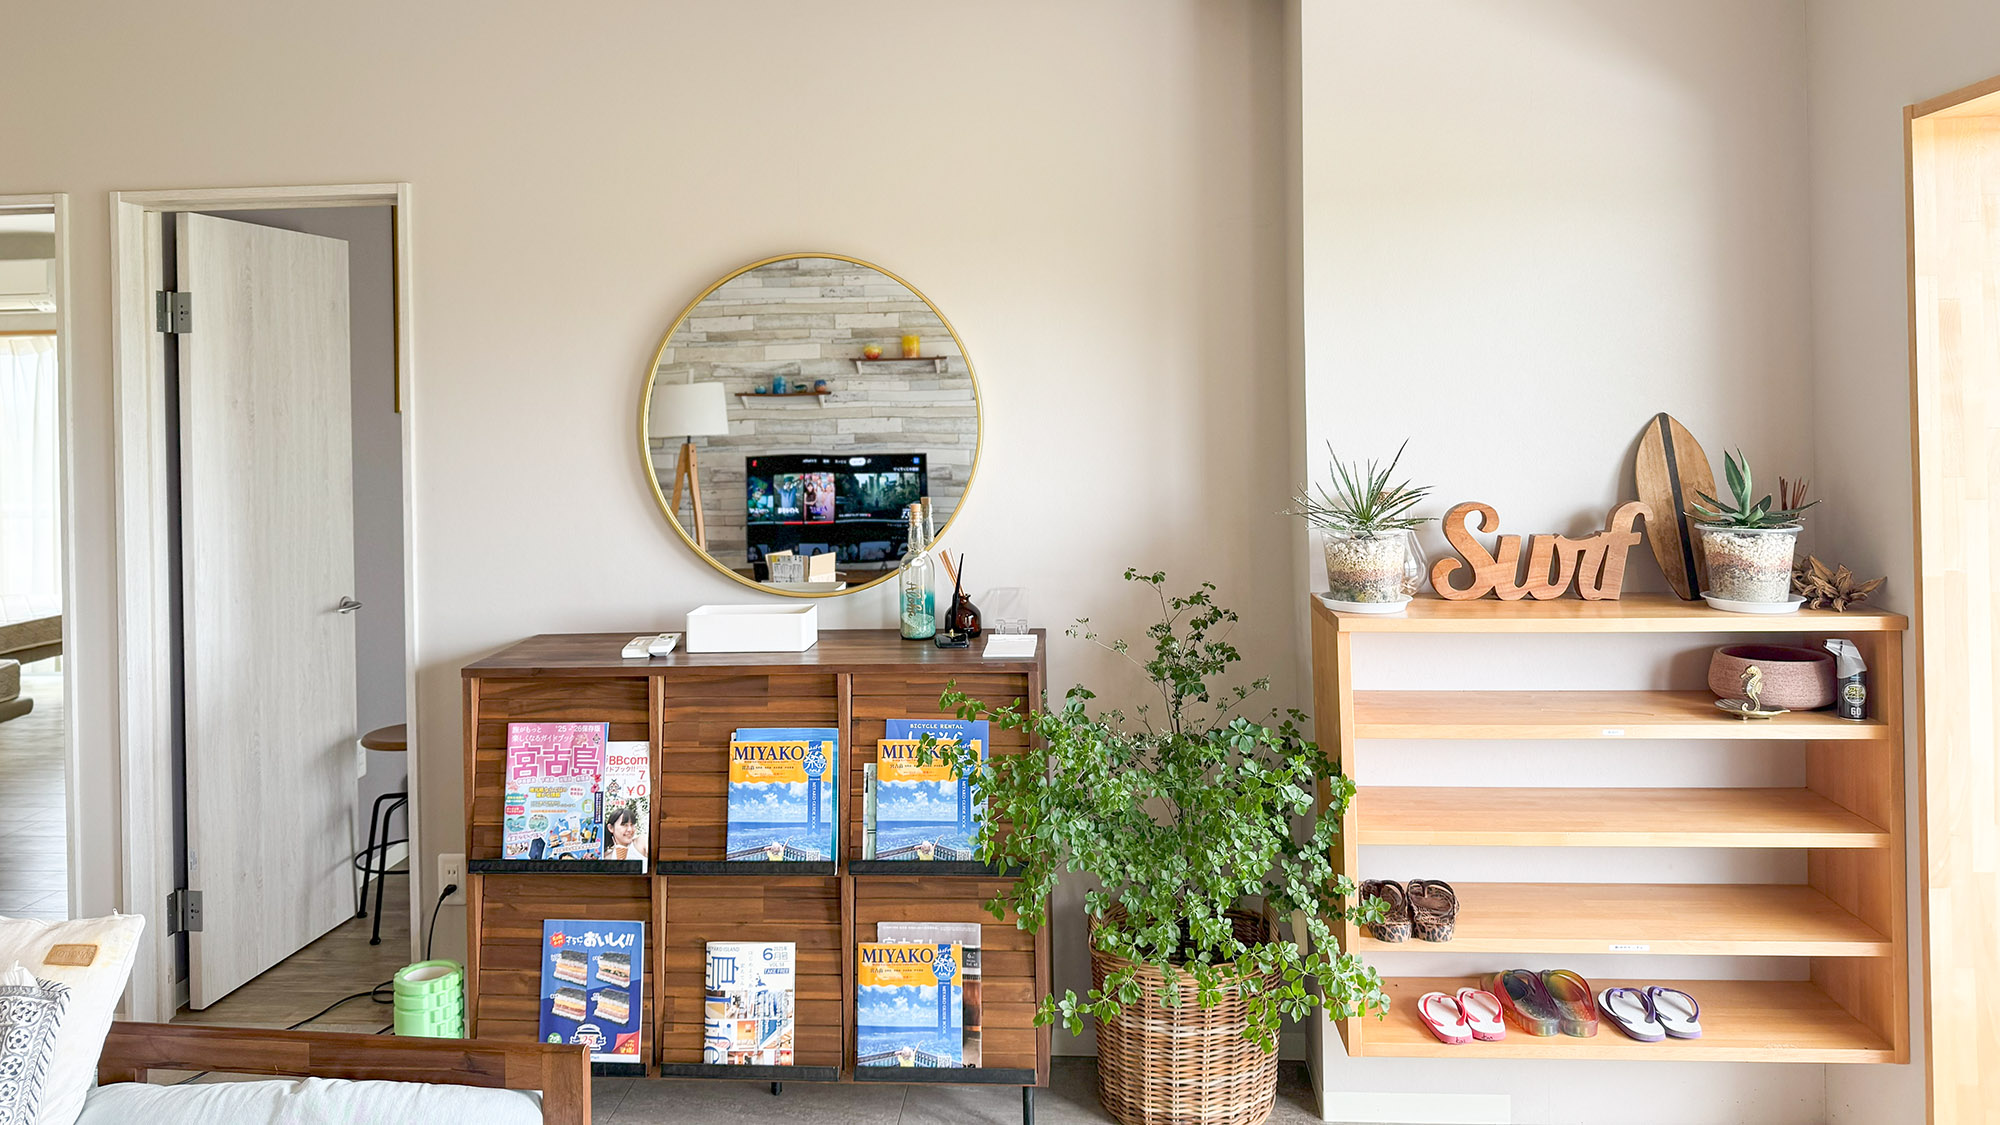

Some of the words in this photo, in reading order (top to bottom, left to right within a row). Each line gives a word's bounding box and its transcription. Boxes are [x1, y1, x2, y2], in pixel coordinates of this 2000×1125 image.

[1430, 501, 1653, 600] Surf
[905, 581, 923, 619] Aloha
[1850, 707, 1861, 716] 60
[609, 755, 648, 765] BBcom
[734, 745, 804, 760] MIYAKO
[510, 742, 599, 780] 宮古島
[639, 770, 645, 779] 7
[862, 948, 933, 963] MIYAKO
